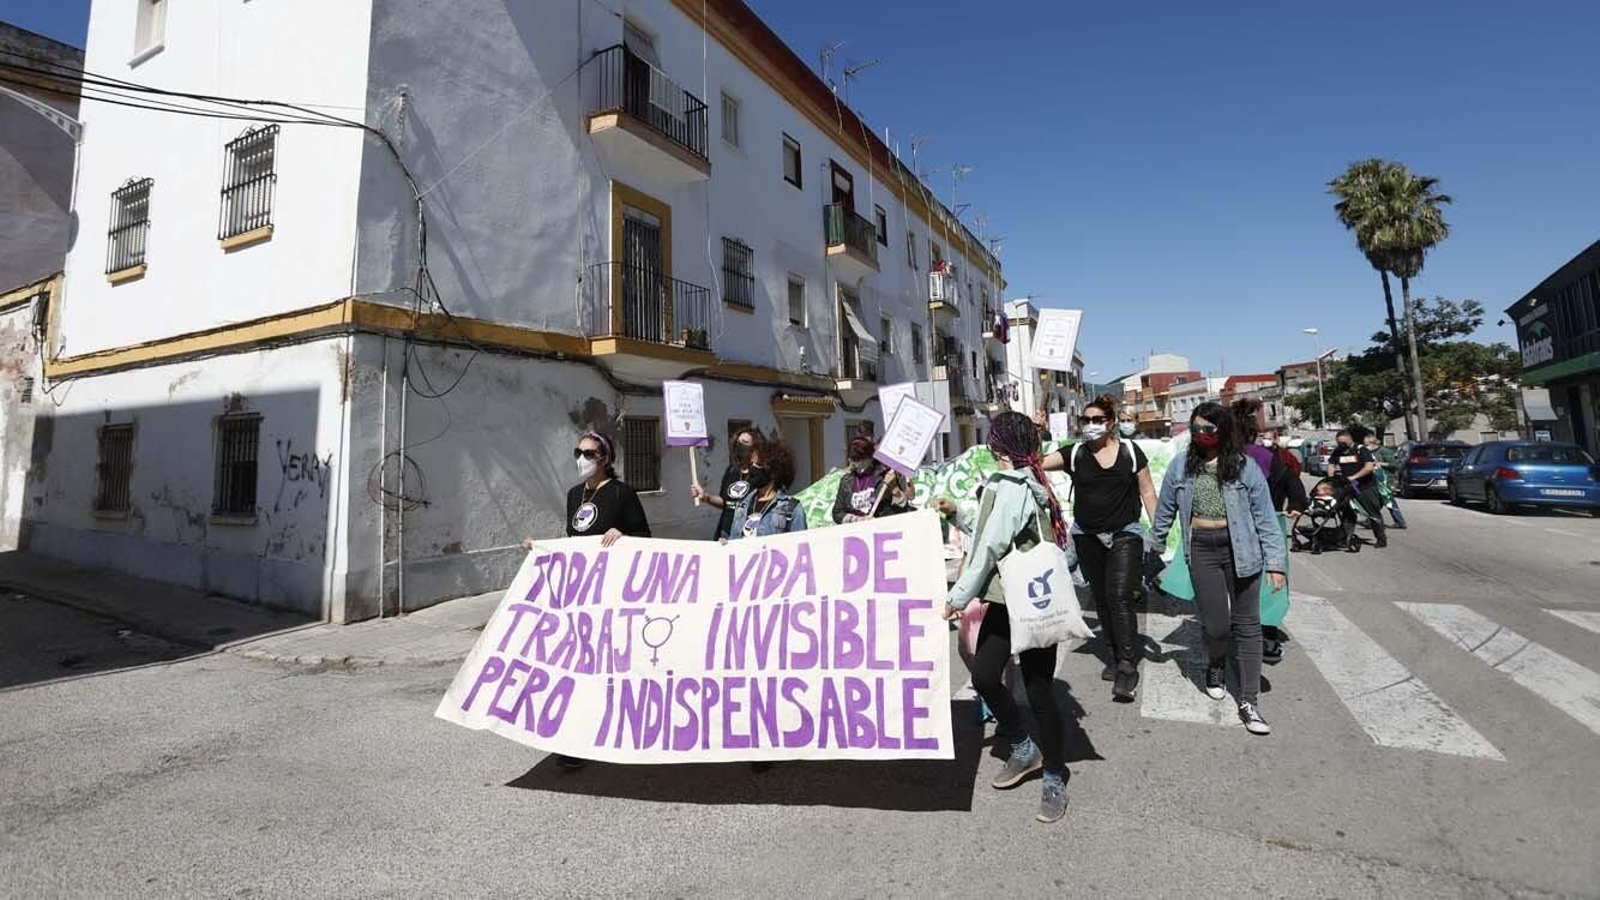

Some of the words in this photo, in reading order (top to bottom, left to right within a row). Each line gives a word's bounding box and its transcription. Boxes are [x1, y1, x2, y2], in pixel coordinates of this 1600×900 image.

[526, 552, 607, 610] TODA
[622, 551, 700, 605] UNA
[844, 532, 907, 594] DE
[462, 656, 576, 738] PERO
